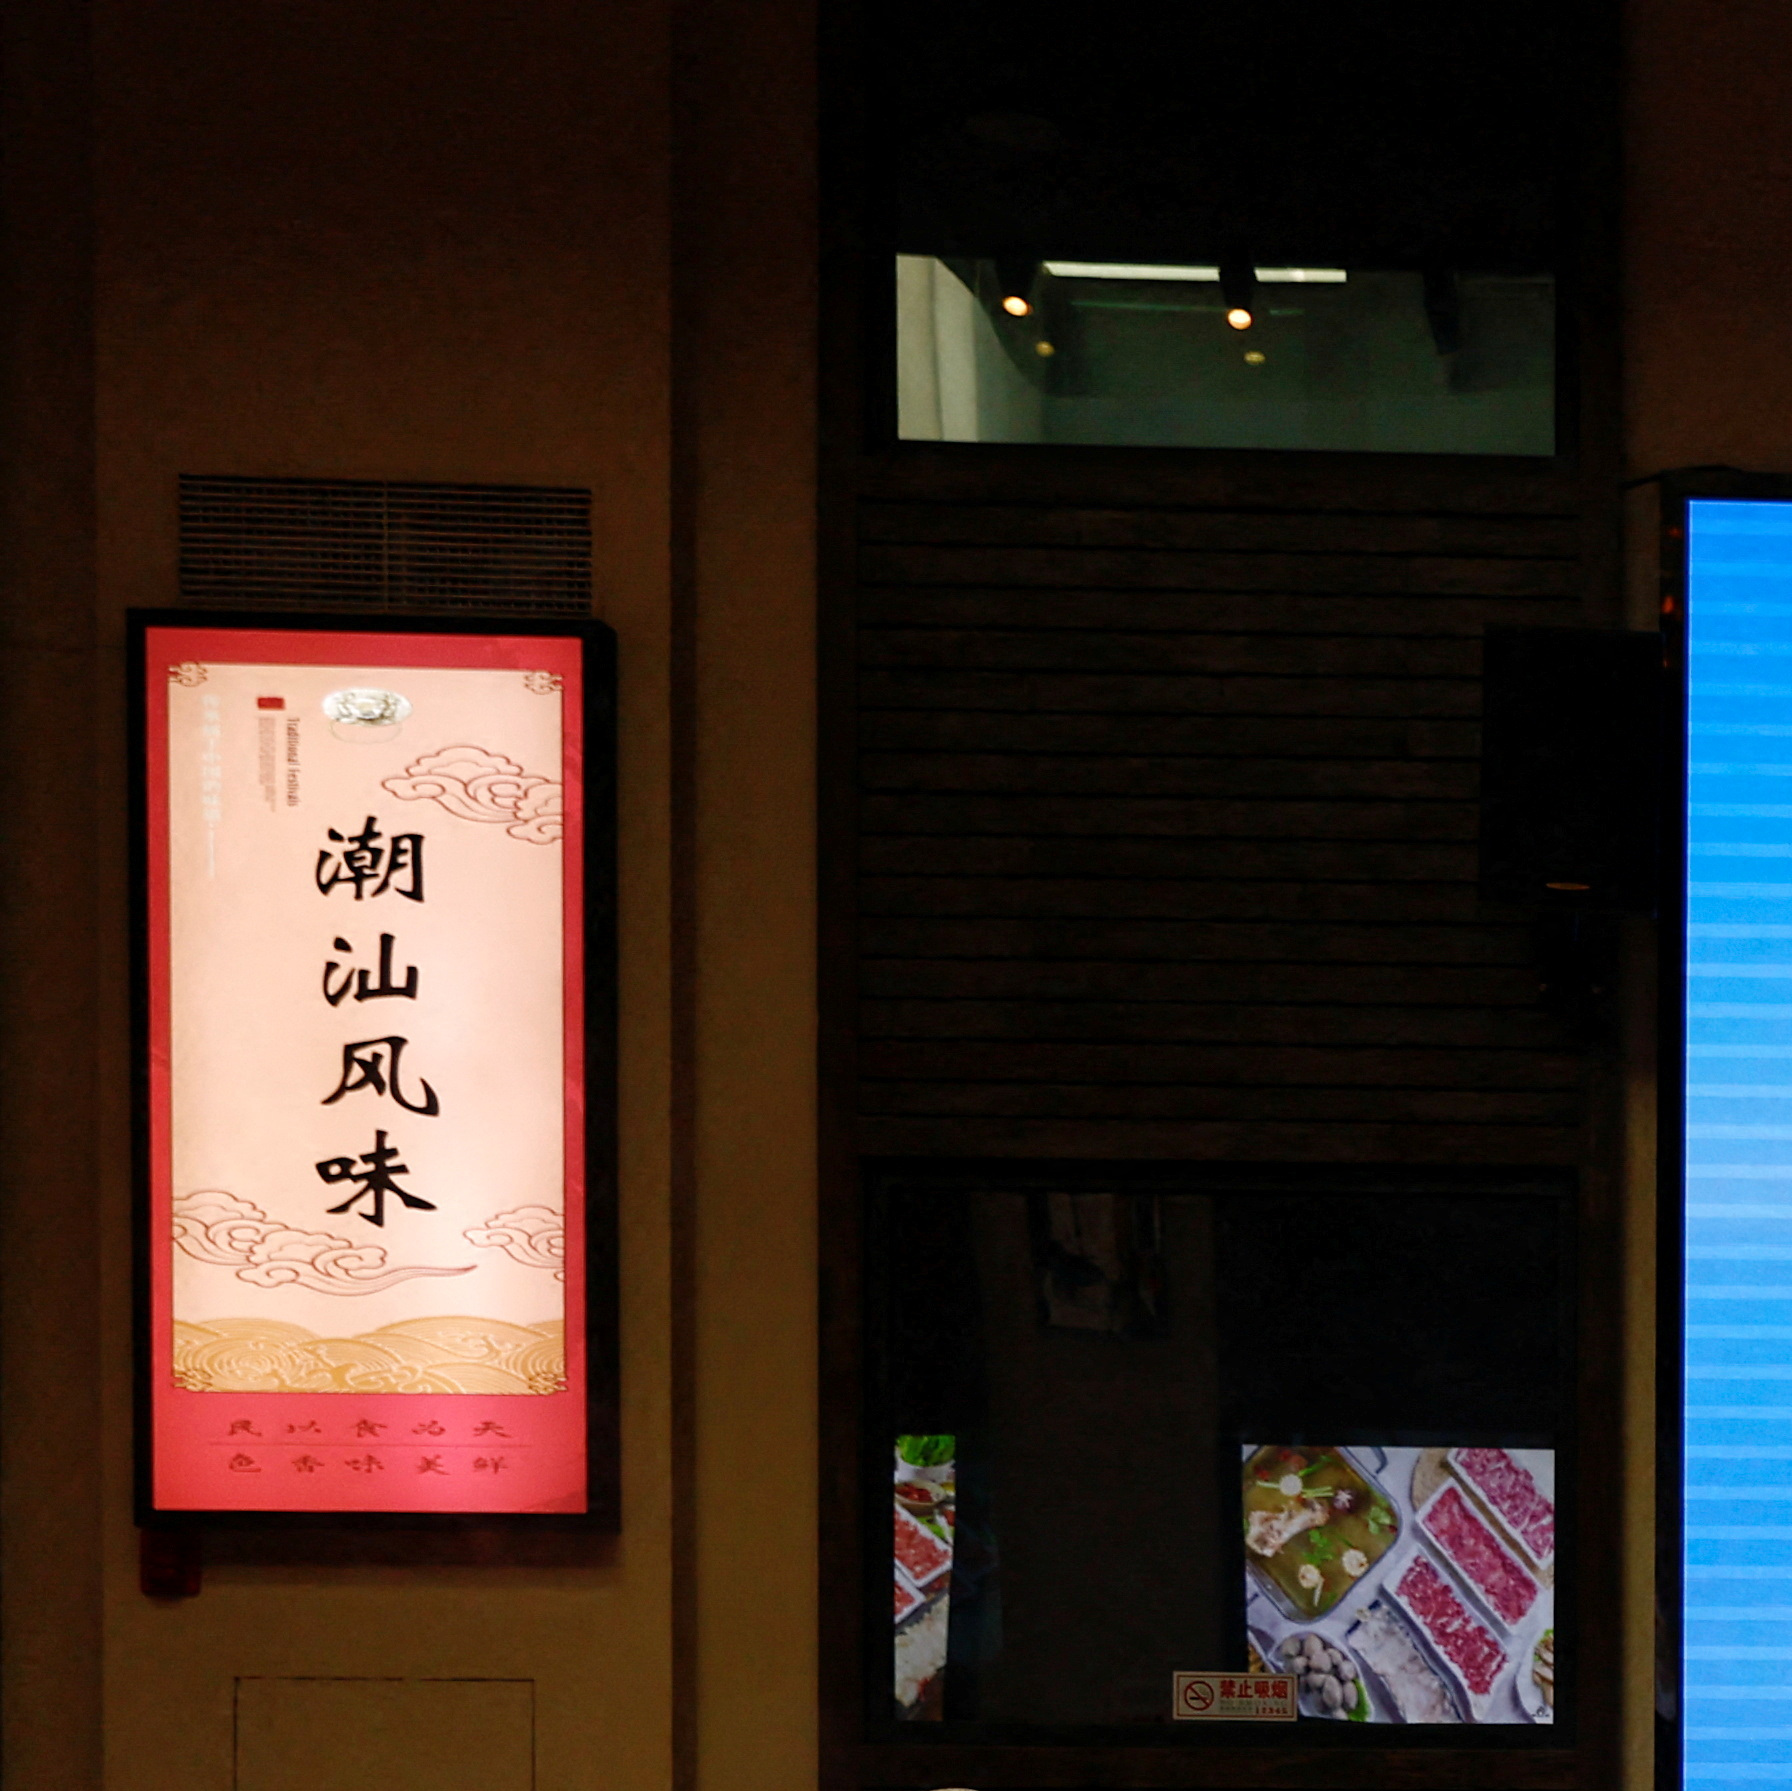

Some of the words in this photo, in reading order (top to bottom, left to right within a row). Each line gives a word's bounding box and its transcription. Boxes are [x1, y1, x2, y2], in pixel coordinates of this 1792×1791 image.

[315, 816, 440, 1227] 潮汕风味
[227, 1419, 512, 1438] 民以食为天
[228, 1453, 510, 1476] 色香味美鲜
[1220, 1679, 1289, 1699] 禁止吸烟
